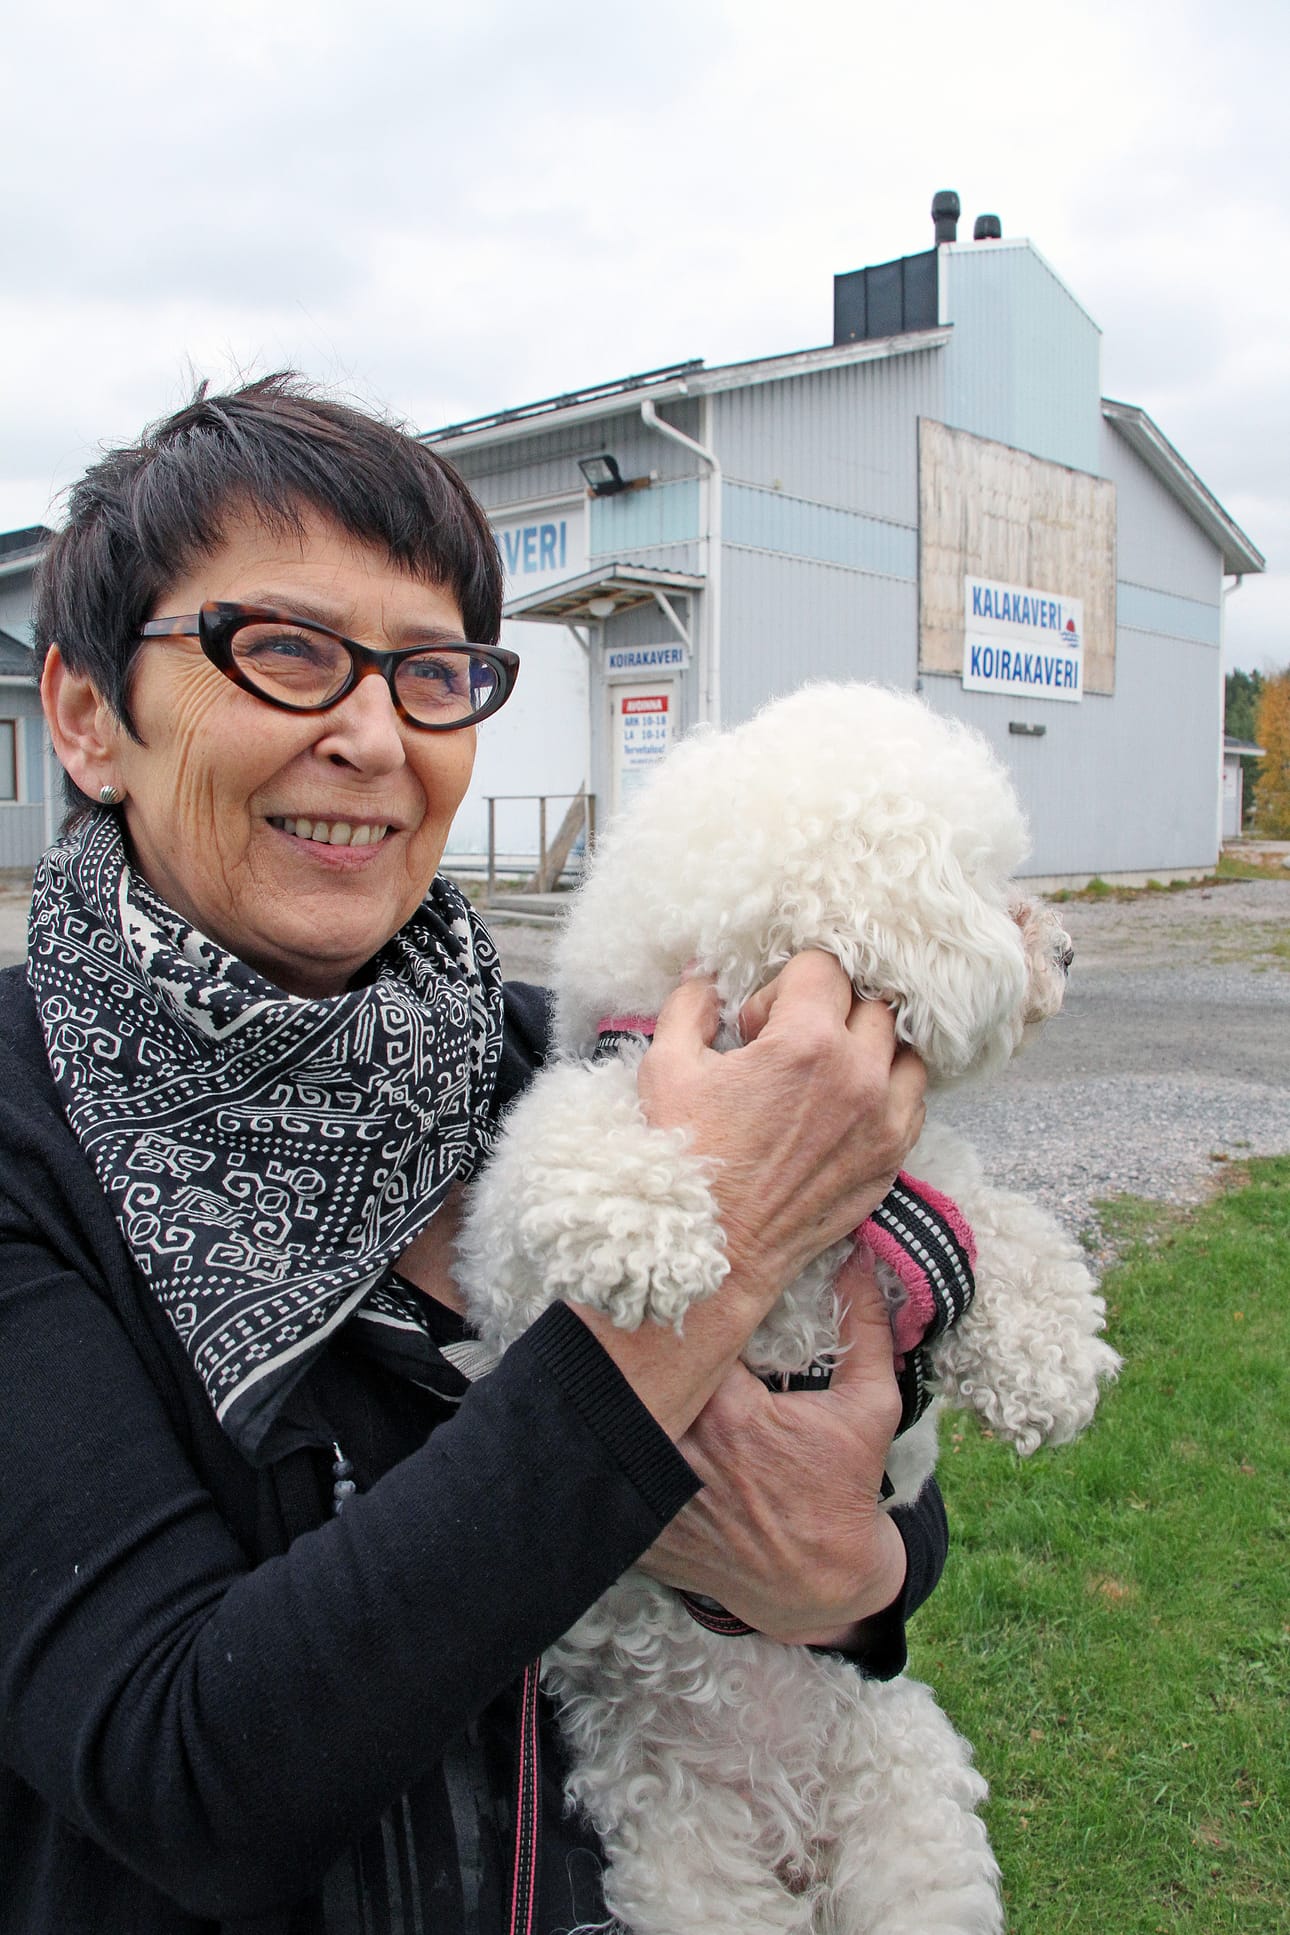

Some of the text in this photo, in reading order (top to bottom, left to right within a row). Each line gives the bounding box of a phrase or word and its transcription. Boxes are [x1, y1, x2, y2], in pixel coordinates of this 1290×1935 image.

[495, 521, 566, 575] VERI
[973, 585, 1061, 631] KALAKAVERI
[609, 649, 682, 668] KOIRAKAVERI
[971, 645, 1078, 689] KOIRAKAVERI
[642, 729, 666, 739] 10-14
